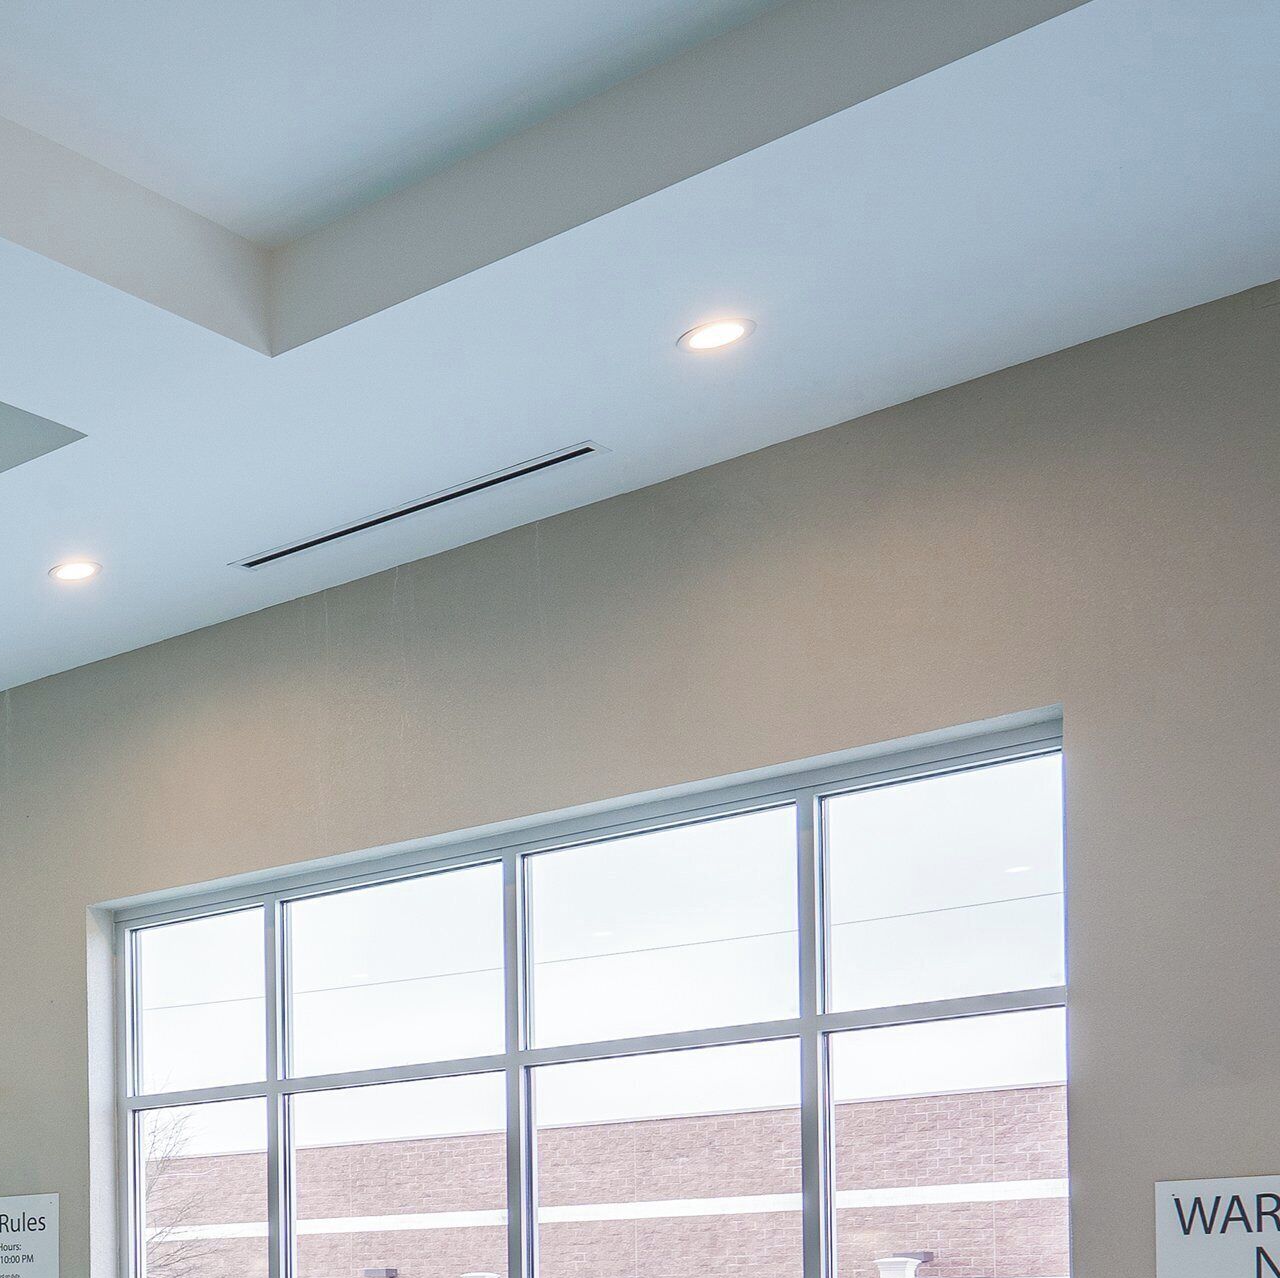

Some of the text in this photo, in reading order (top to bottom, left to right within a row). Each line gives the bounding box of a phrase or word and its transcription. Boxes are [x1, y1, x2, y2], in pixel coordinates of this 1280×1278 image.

[0, 1212, 46, 1233] Rules
[1173, 1193, 1280, 1235] WAR
[21, 1254, 34, 1263] PM
